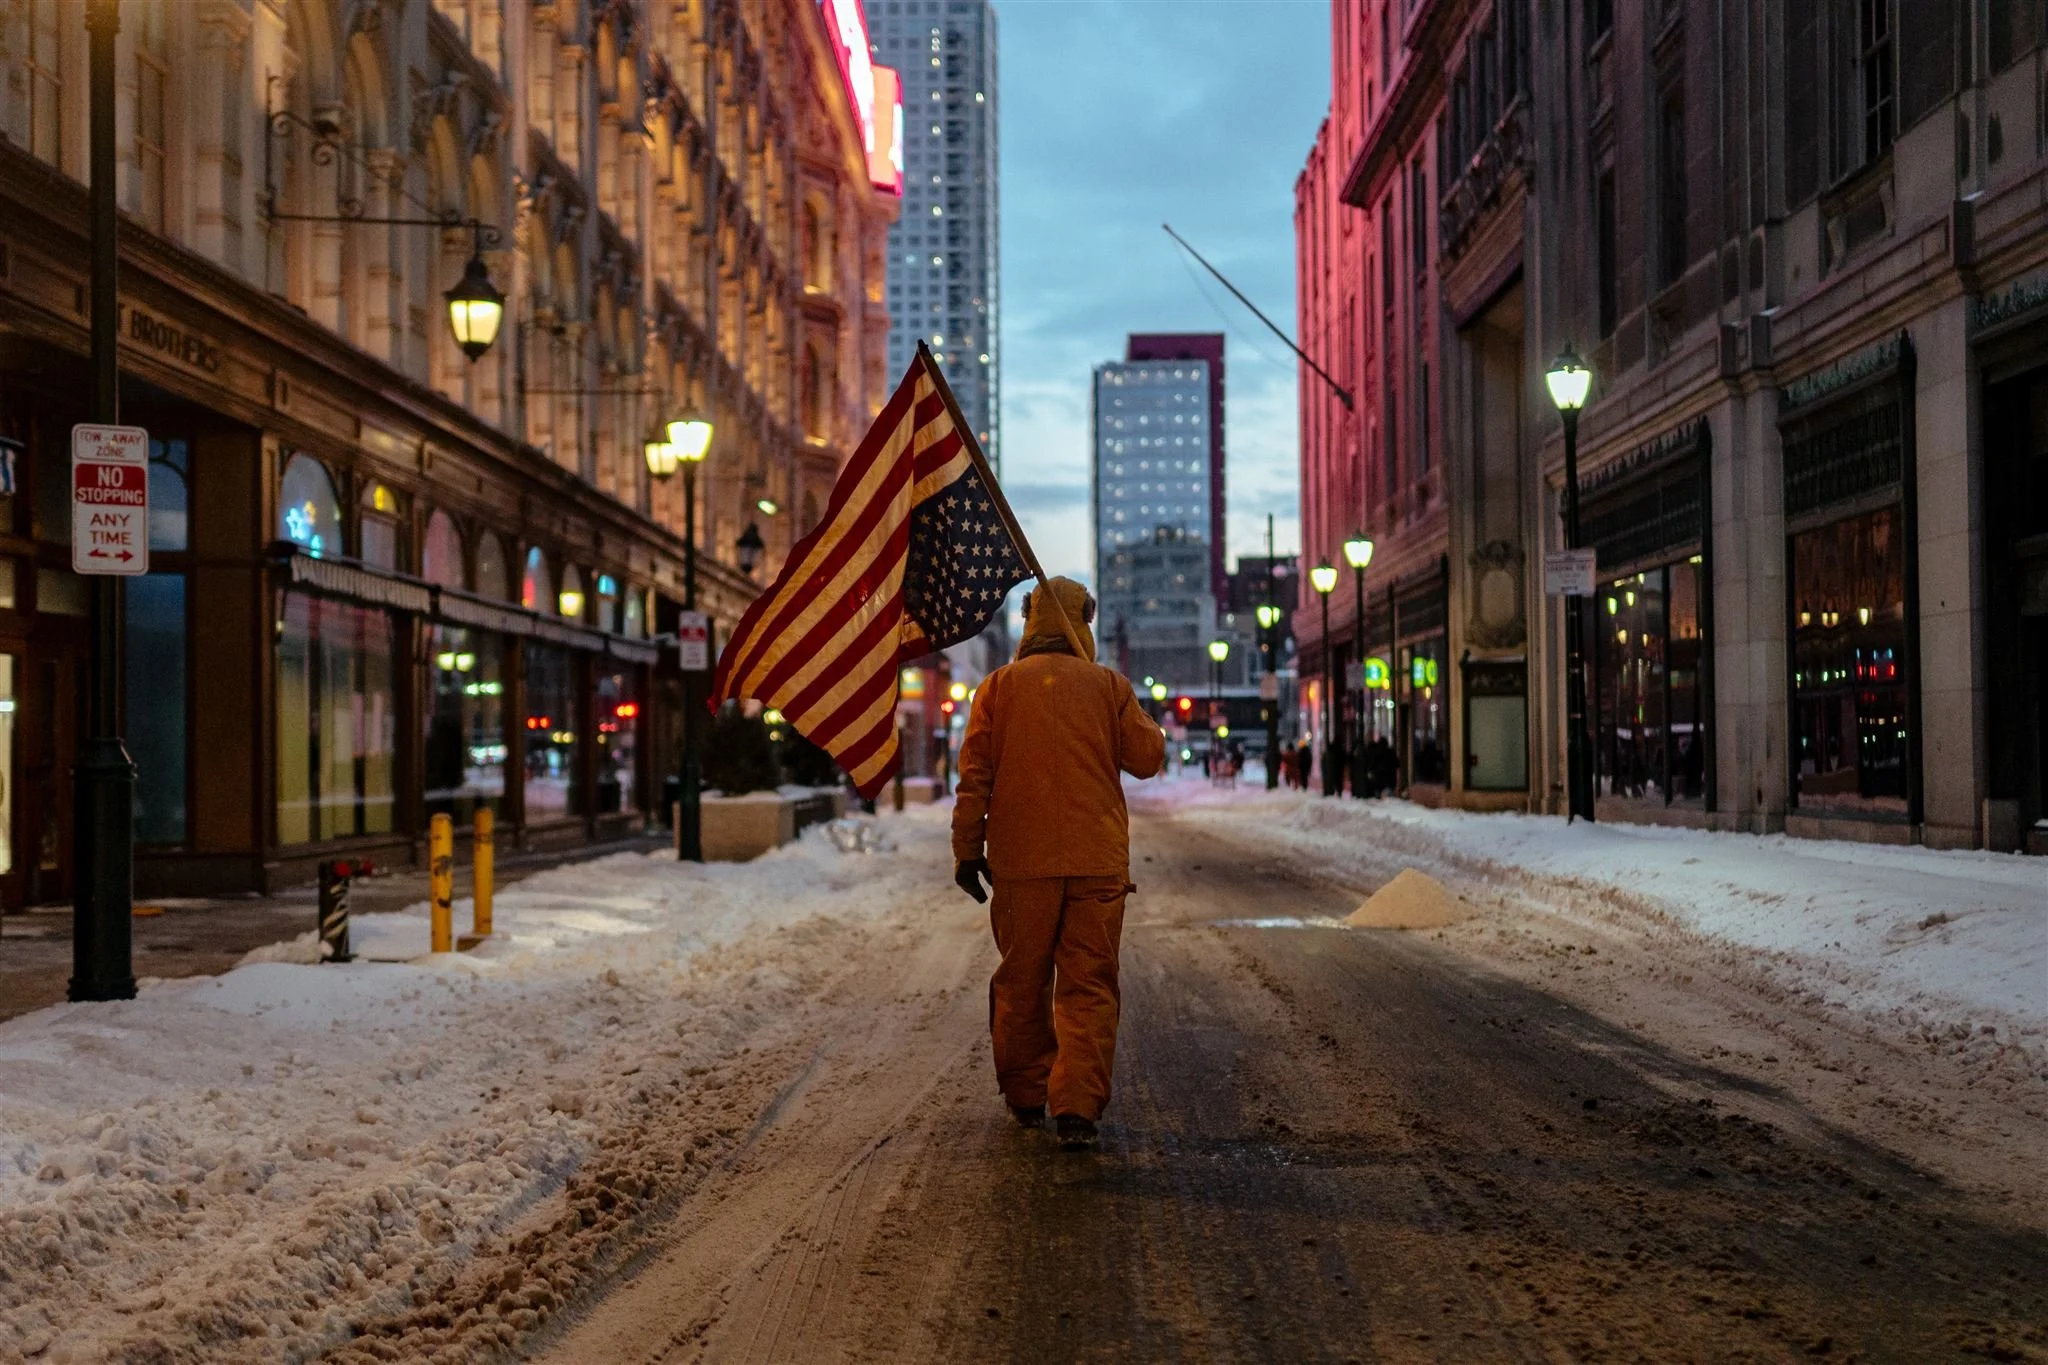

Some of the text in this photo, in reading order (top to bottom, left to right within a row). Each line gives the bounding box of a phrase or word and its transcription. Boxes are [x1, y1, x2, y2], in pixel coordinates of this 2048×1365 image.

[130, 309, 219, 373] BROTHERS
[96, 446, 125, 458] ZONE
[97, 466, 124, 488] NO
[77, 487, 143, 504] STOPPING
[90, 513, 131, 527] ANY
[90, 530, 132, 545] TIME
